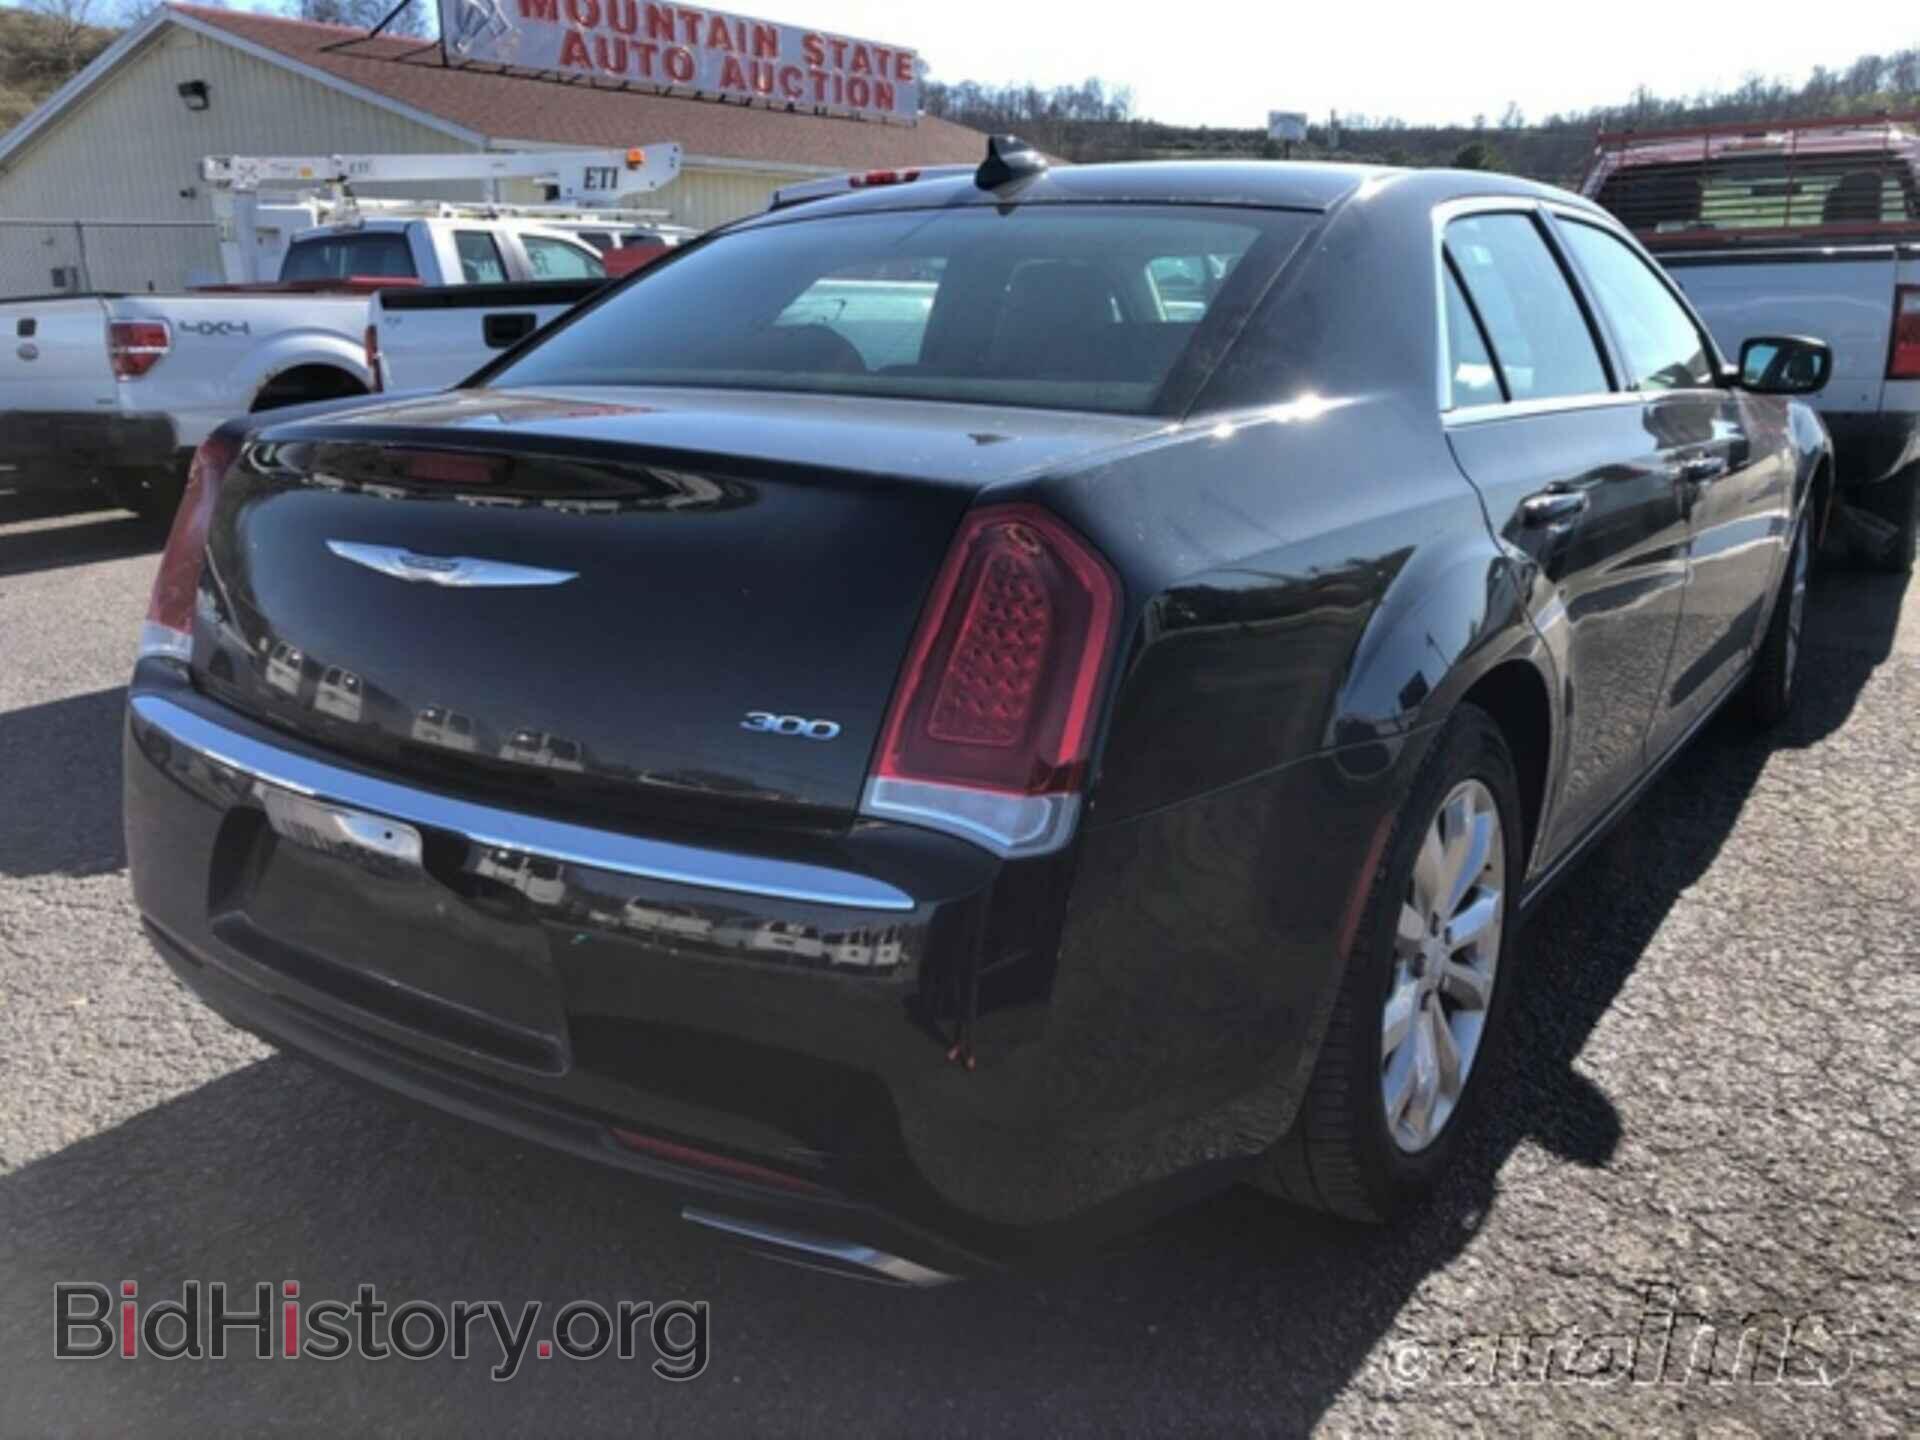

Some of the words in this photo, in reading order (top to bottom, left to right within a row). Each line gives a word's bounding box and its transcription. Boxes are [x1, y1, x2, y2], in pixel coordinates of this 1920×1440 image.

[517, 0, 779, 59] MOUNTAIN
[802, 32, 914, 82] STATE
[559, 29, 697, 81] AUTO
[719, 56, 896, 112] AUCTION
[583, 166, 619, 190] ETI
[740, 711, 840, 741] 300
